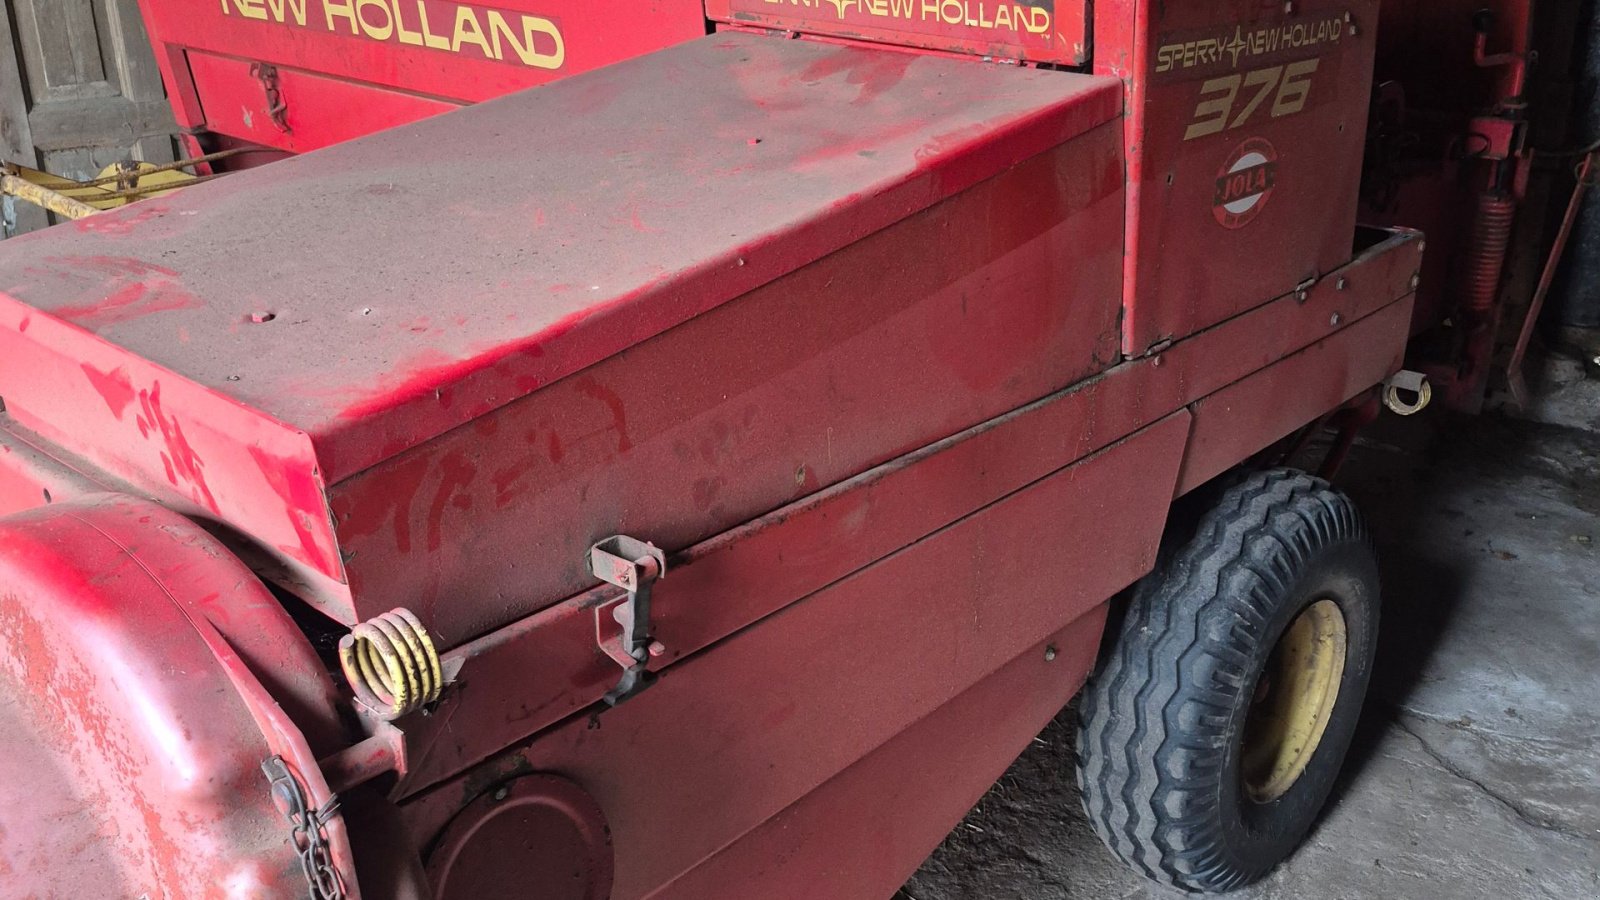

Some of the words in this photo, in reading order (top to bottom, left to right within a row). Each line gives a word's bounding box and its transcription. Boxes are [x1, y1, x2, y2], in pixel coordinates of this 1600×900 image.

[322, 0, 566, 70] HOLLAND
[921, 0, 1050, 34] HOLLAND
[1155, 36, 1228, 73] SPERRY
[1245, 27, 1281, 56] NEW
[1281, 18, 1341, 50] HOLLAND
[1183, 58, 1320, 141] 376
[1222, 167, 1266, 201] JOLA
